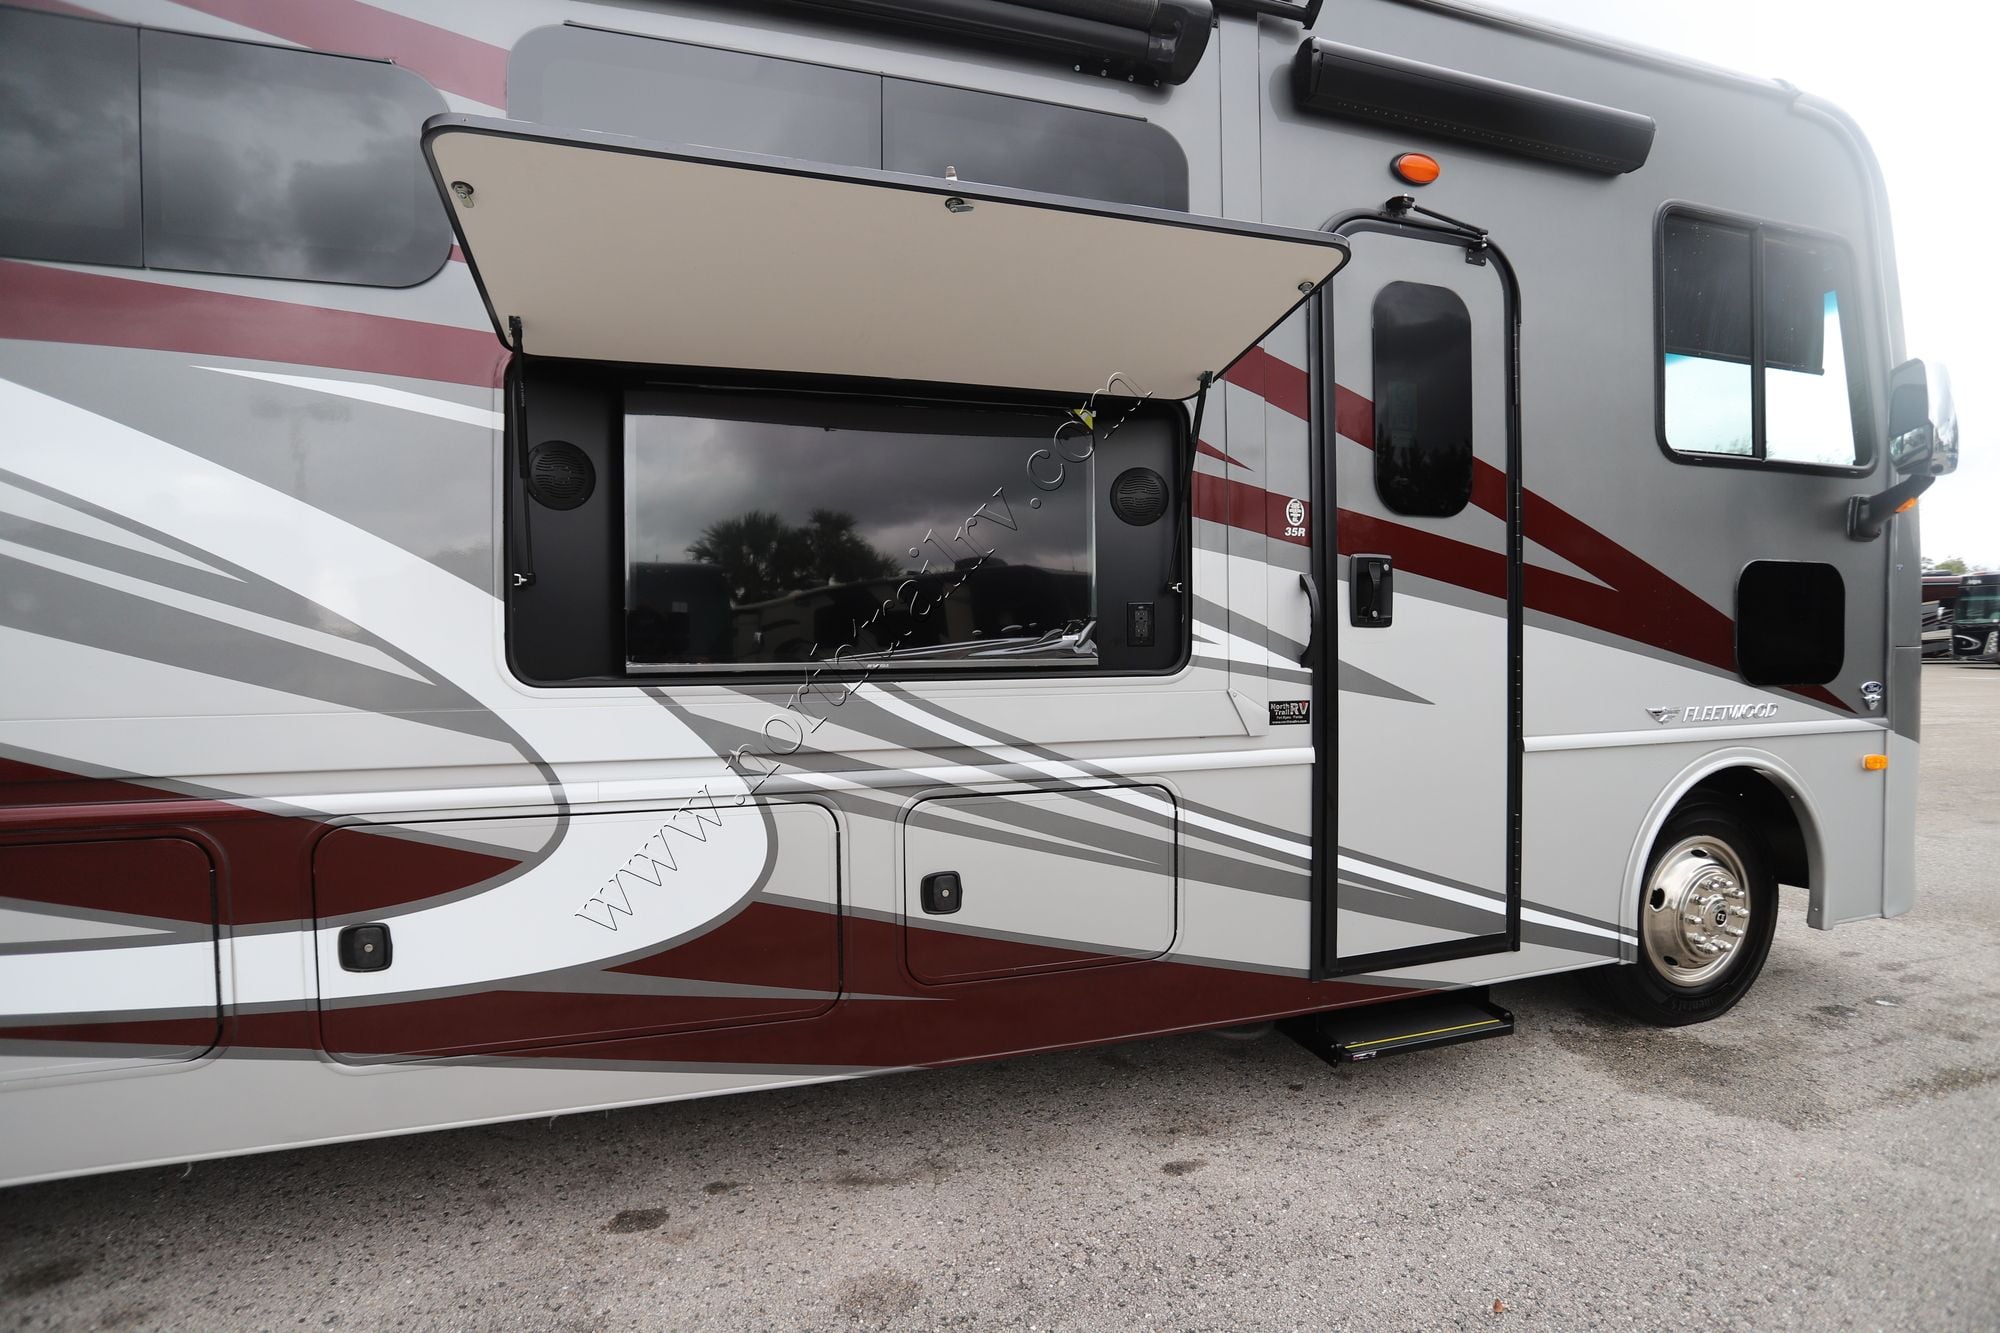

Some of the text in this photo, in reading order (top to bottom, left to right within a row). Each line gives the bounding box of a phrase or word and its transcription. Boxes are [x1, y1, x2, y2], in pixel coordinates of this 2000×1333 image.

[1285, 527, 1305, 537] 35R
[1290, 702, 1309, 715] RV
[1683, 703, 1778, 722] FLEETWOOD
